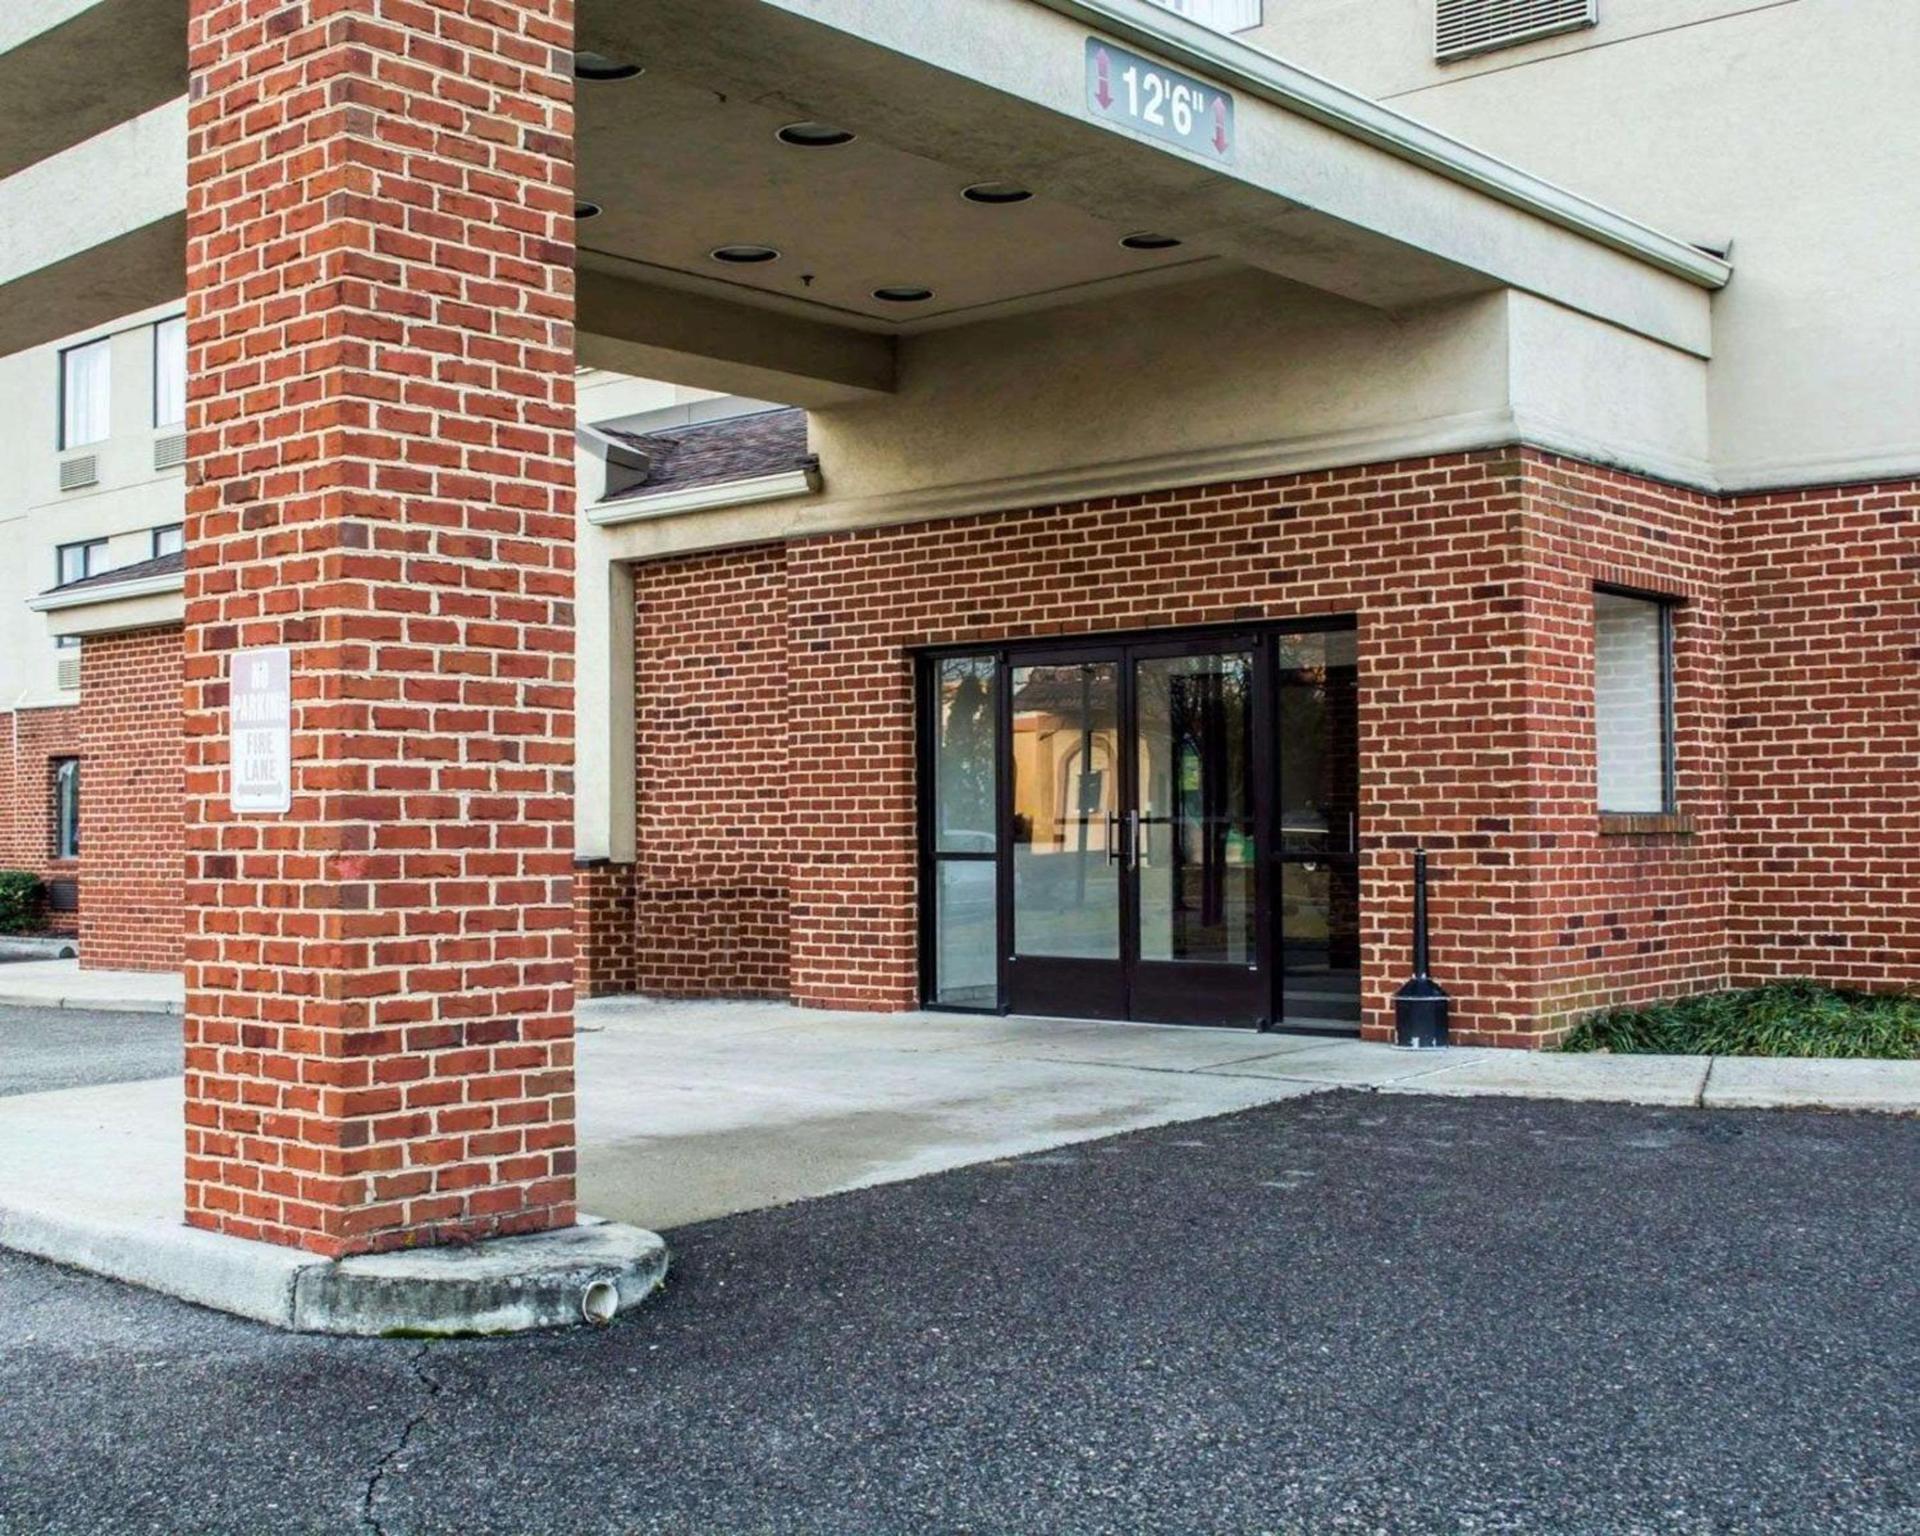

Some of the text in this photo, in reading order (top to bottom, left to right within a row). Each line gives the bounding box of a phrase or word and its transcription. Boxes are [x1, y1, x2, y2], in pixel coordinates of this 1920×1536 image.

[1122, 66, 1204, 136] 12'6"
[251, 661, 270, 689] NO
[233, 691, 288, 721] PARKING
[246, 732, 274, 755] FIRE
[244, 758, 277, 782] LANE
